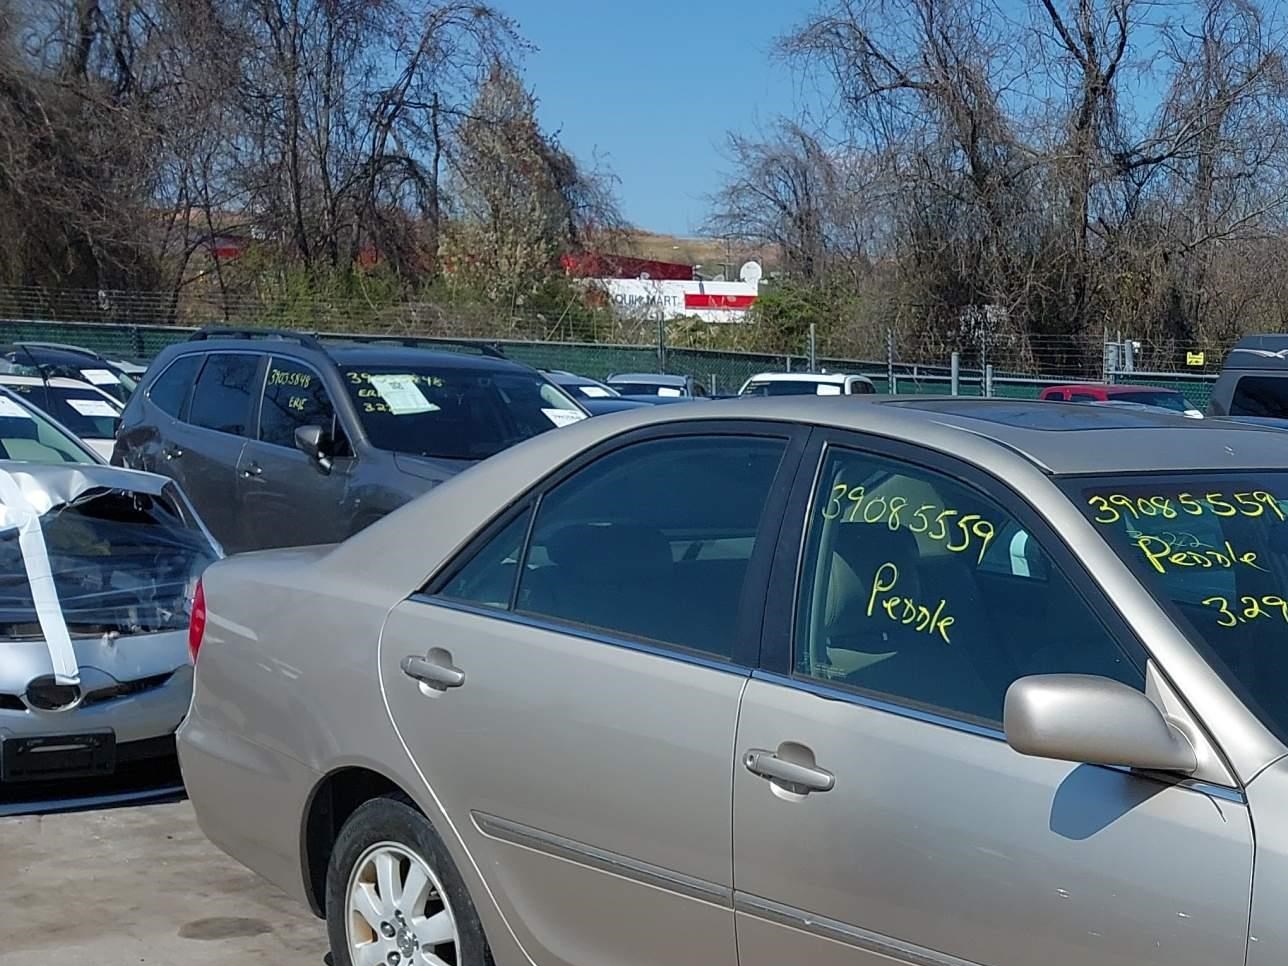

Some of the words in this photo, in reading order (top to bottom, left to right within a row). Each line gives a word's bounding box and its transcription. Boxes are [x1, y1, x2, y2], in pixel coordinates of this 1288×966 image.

[646, 294, 678, 306] MART
[1087, 490, 1287, 523] 39085559
[821, 483, 994, 565] 39085559
